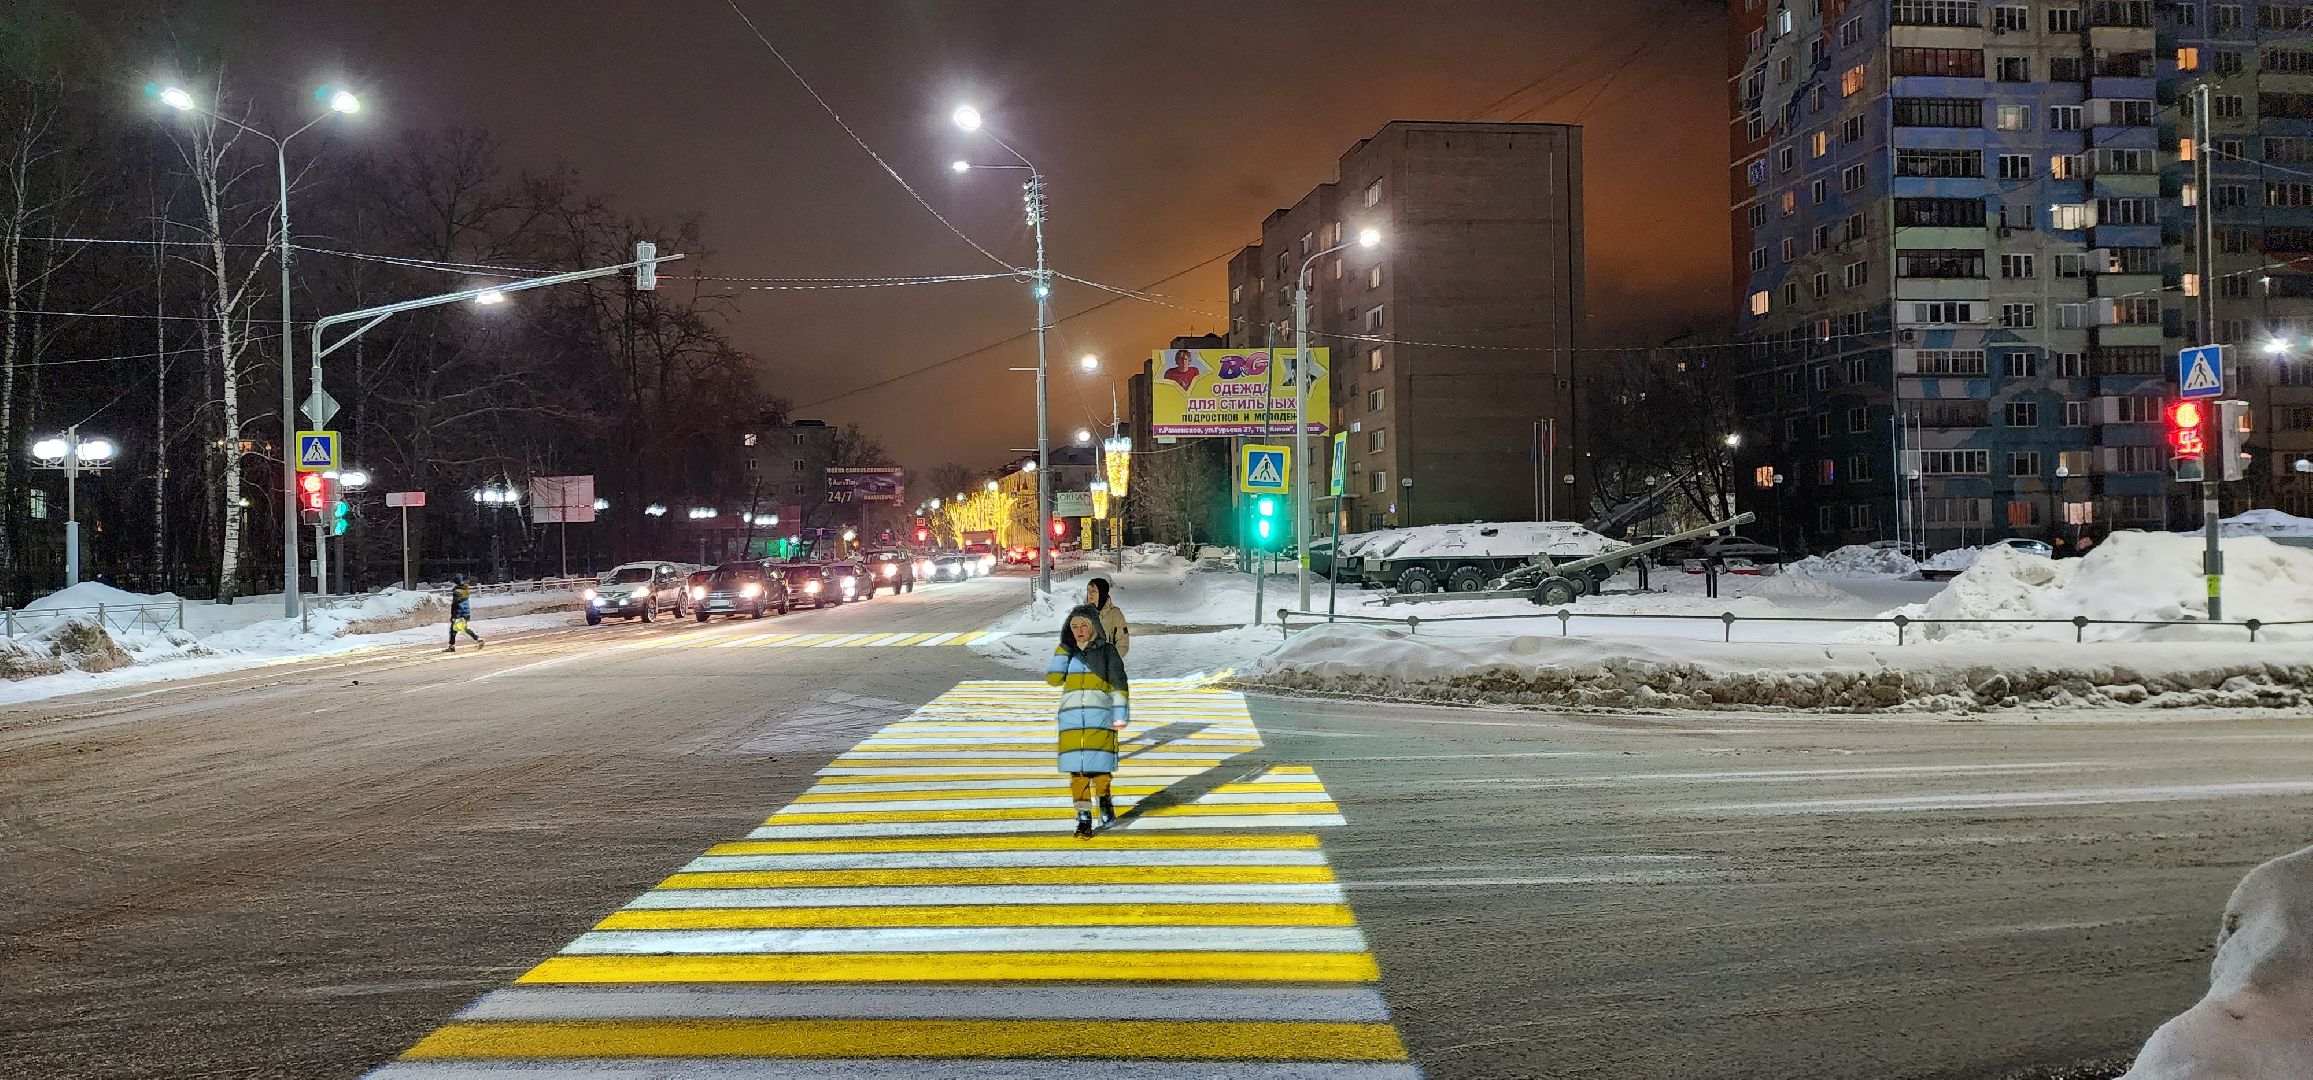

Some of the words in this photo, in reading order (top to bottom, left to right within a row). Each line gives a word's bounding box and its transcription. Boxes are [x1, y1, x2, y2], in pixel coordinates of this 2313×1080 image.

[1188, 399, 1215, 412] ДЛЯ
[1182, 413, 1238, 423] ПОДРОСТКОВ
[1243, 413, 1250, 422] И
[1254, 412, 1297, 422] МОЛОДЕЖ
[827, 491, 853, 503] 24/7
